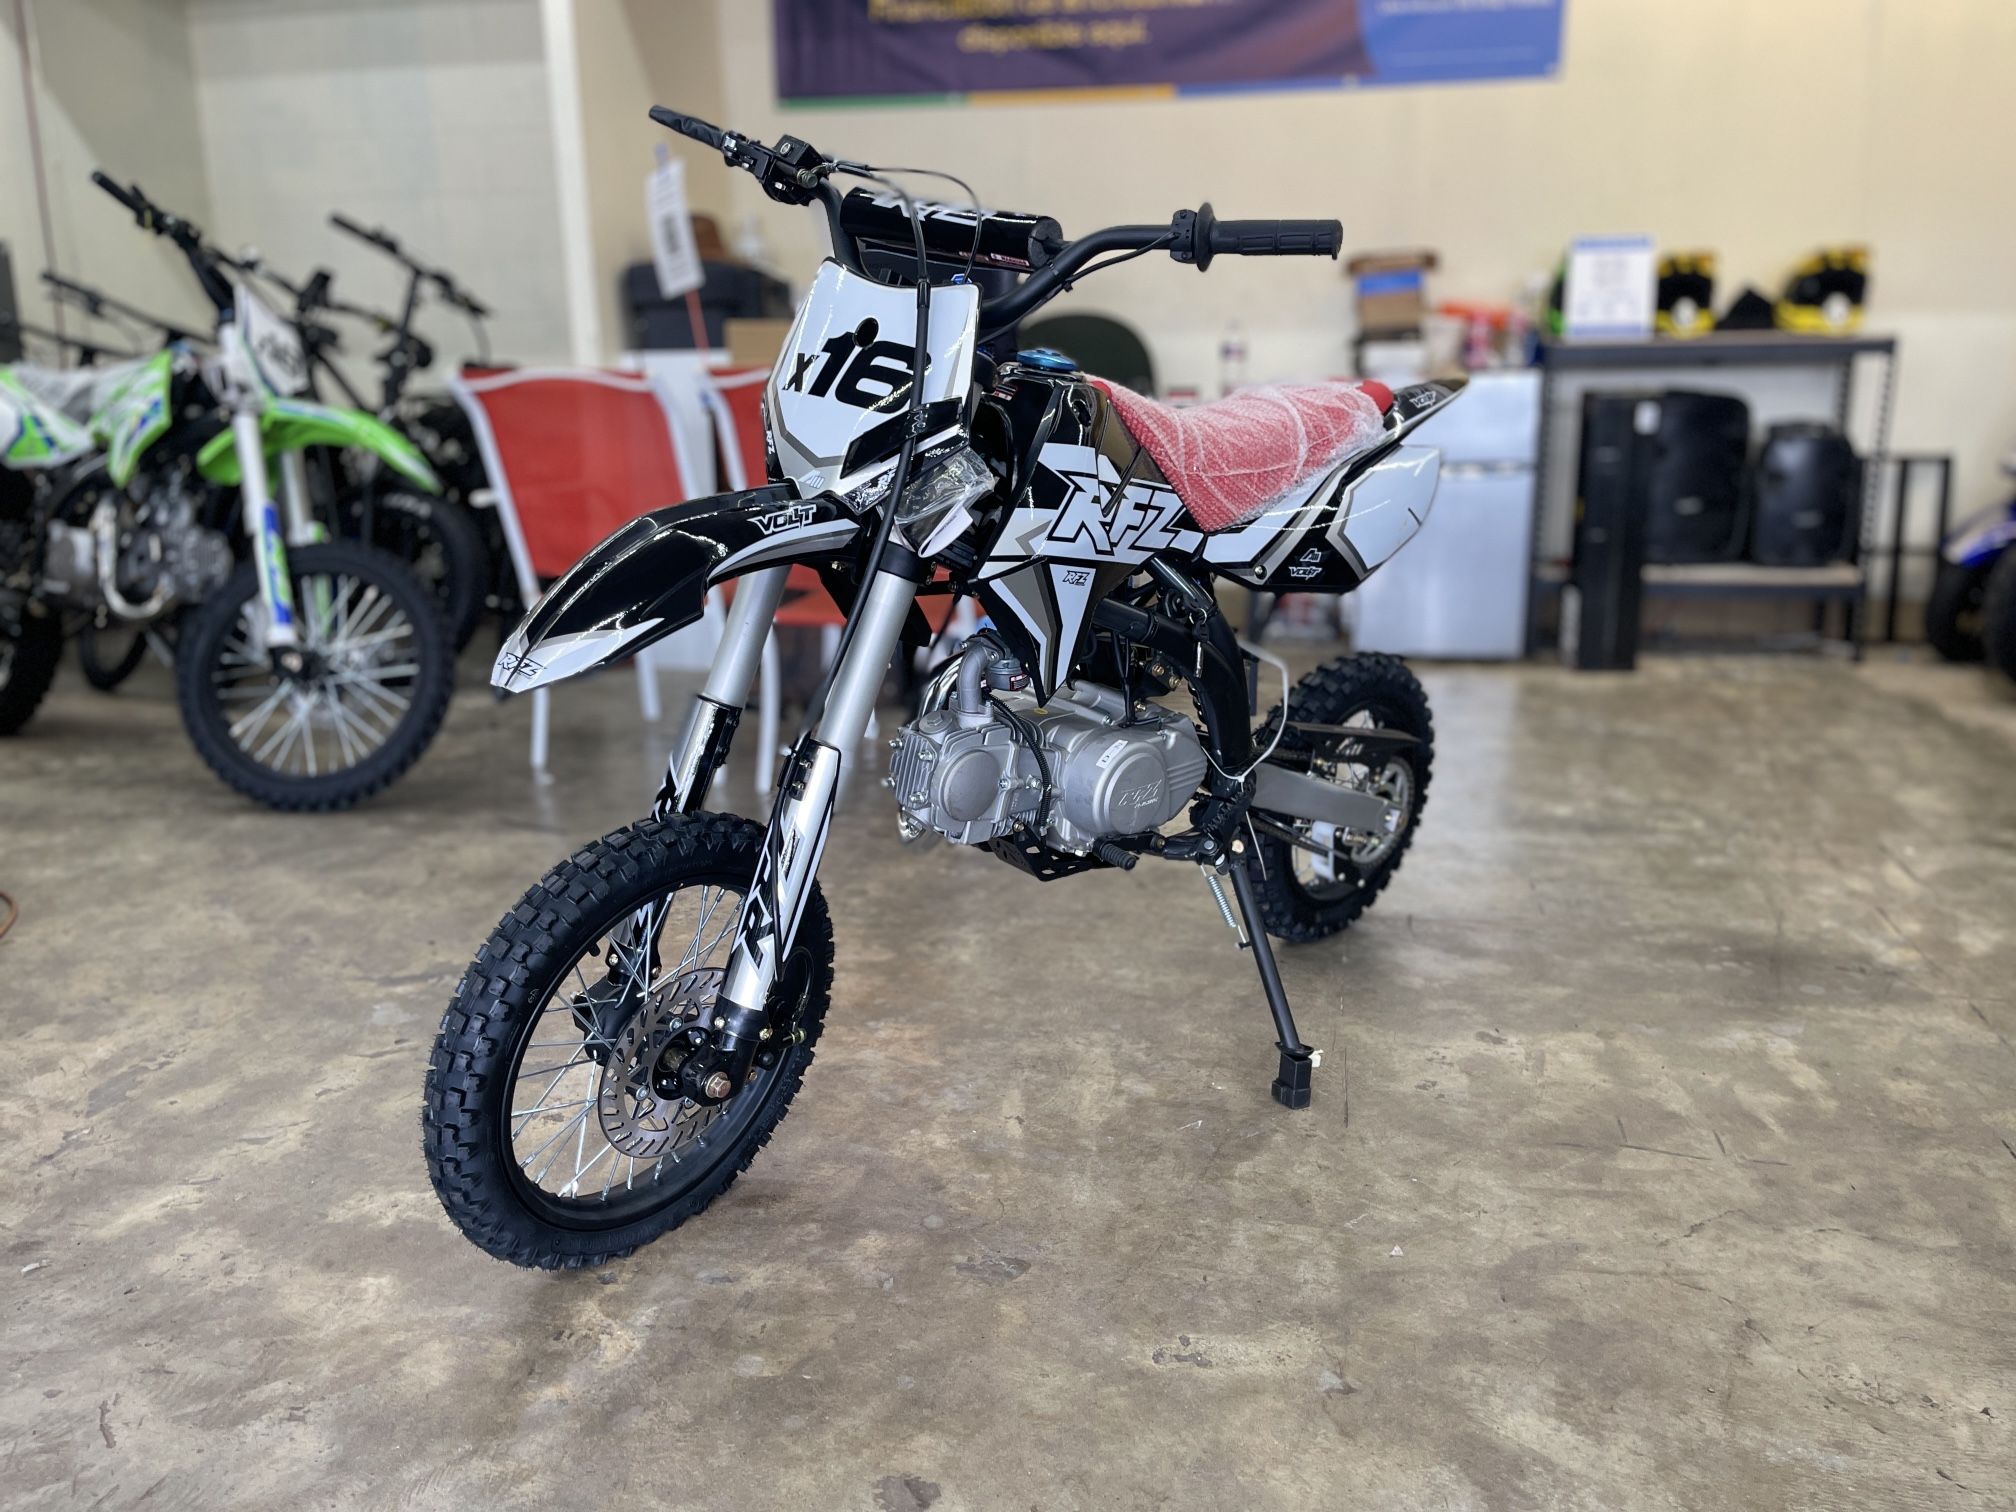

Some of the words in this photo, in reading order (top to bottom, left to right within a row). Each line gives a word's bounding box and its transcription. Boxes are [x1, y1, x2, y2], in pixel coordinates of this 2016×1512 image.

[746, 503, 817, 535] VOLT
[1046, 469, 1187, 556] RFZ
[1062, 570, 1090, 585] RFZ
